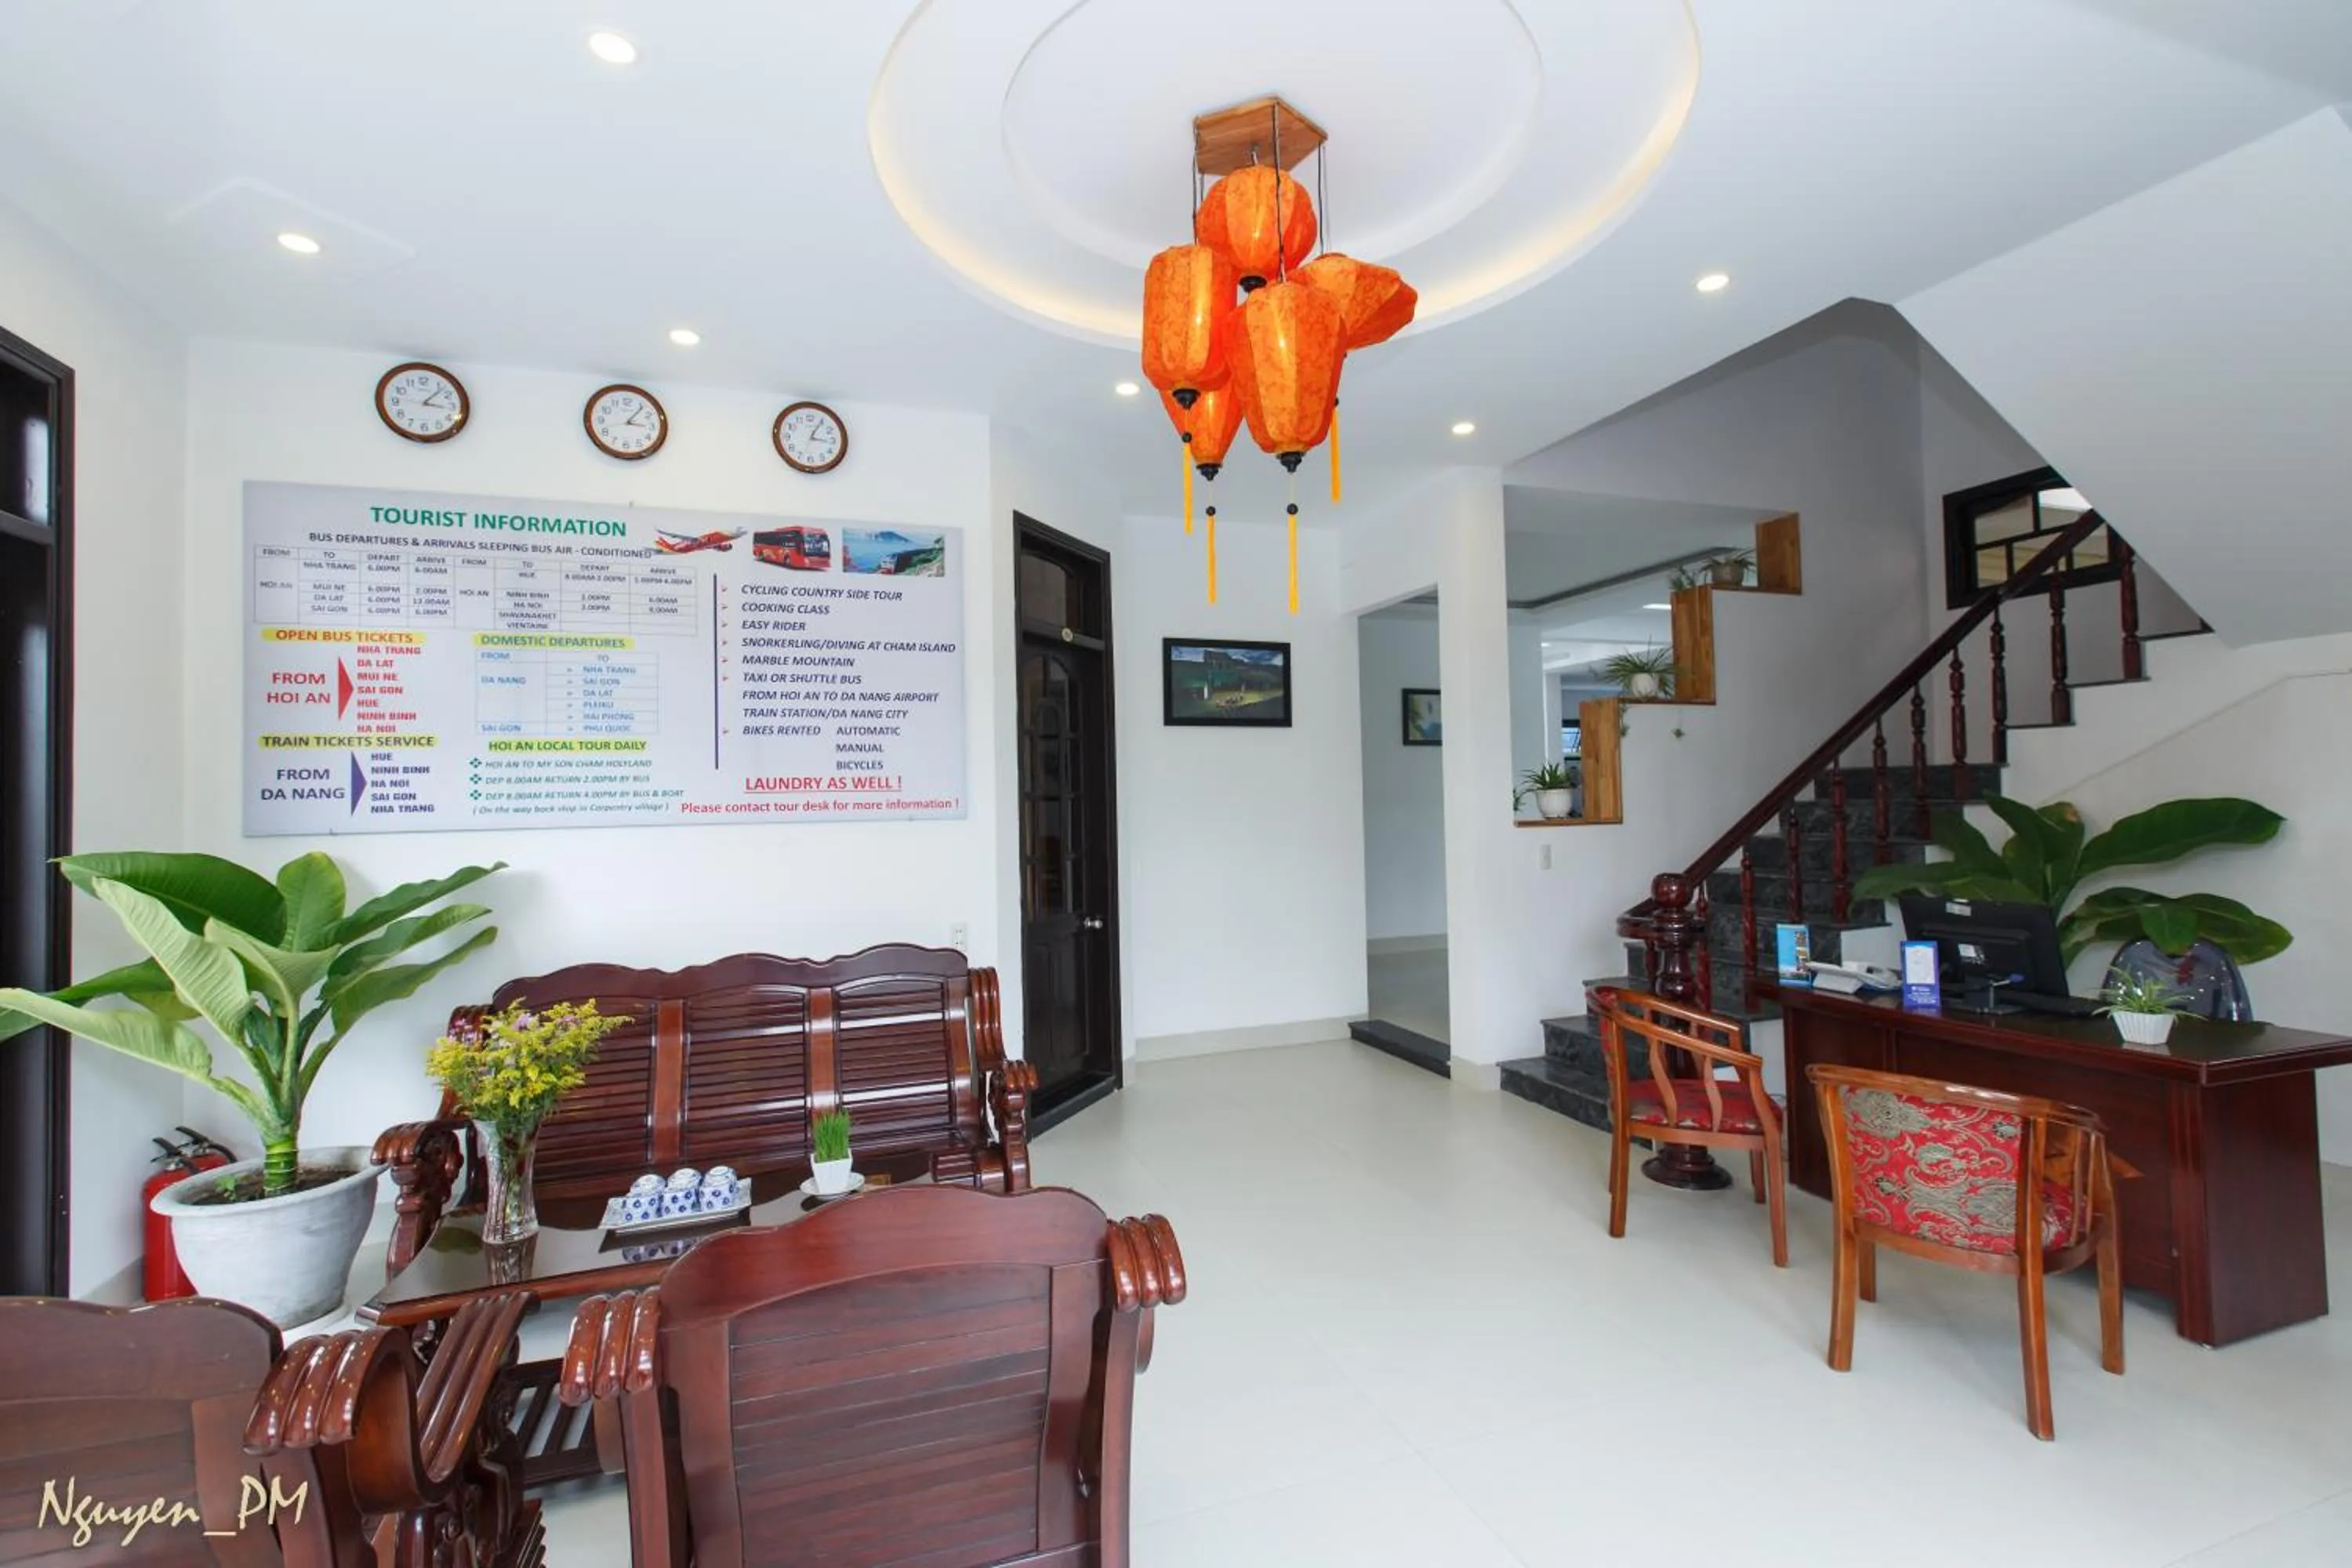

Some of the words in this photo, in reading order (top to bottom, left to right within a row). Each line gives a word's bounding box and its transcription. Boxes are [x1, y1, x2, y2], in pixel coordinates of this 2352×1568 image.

[370, 507, 466, 528] TOURIST
[474, 513, 626, 537] INFORMATION
[310, 532, 332, 543] BUS
[336, 534, 408, 546] DEPARTURES
[411, 538, 419, 546] &
[423, 539, 476, 550] ARRIVALS
[478, 541, 528, 553] SLEEPING
[532, 545, 552, 554] BUS
[555, 546, 572, 555] AIR
[581, 546, 652, 559] CONDITIONED
[741, 584, 789, 597] CYCLING
[791, 586, 844, 599] COUNTRY
[847, 589, 870, 600] SIDE
[874, 590, 902, 601] TOUR
[741, 602, 794, 614] COOKING
[797, 604, 830, 615] CLASS
[742, 620, 771, 630] EASY
[772, 621, 807, 632] RIDER
[276, 629, 318, 641] OPEN
[322, 630, 352, 641] BUS
[357, 632, 413, 643] TICKETS
[481, 634, 546, 647] DOMESTIC
[549, 637, 626, 648] DEPARTURES
[358, 644, 381, 654] NHA
[385, 646, 421, 655] TRANG
[742, 637, 865, 652] SNORKERLING/DIVING
[867, 641, 881, 652] AT
[884, 642, 917, 652] CHAM
[918, 643, 956, 653] ISLAND
[358, 659, 372, 668] DA
[376, 659, 394, 668] LAT
[742, 655, 789, 666] MARBLE
[792, 656, 856, 667] MOUNTAIN
[272, 673, 325, 684] FROM
[358, 673, 379, 681] MUI
[383, 673, 399, 681] NE
[742, 673, 768, 683] TAXI
[770, 673, 787, 683] OR
[789, 673, 837, 684] SHUTTLE
[840, 674, 863, 685] BUS
[357, 685, 376, 694] SAI
[379, 686, 404, 695] GON
[267, 692, 299, 704] HOI
[305, 692, 331, 704] AN
[358, 699, 379, 707] HUE
[742, 691, 777, 701] FROM
[780, 691, 801, 702] HOI
[804, 691, 820, 702] AN
[824, 692, 838, 702] TO
[841, 692, 858, 703] DA
[861, 692, 891, 704] NANG
[893, 693, 940, 704] AIRPORT
[358, 711, 386, 720] NINH
[389, 712, 417, 720] BINH
[743, 708, 778, 719] TRAIN
[781, 708, 848, 720] STATION/DA
[851, 710, 883, 720] NANG
[886, 710, 909, 720] CITY
[358, 724, 372, 733] HA
[376, 725, 397, 734] NOI
[742, 726, 775, 737] BIKES
[778, 726, 822, 737] RENTED
[836, 727, 902, 737] AUTOMATIC
[263, 735, 310, 747] TRAIN
[314, 735, 372, 747] TICKETS
[376, 736, 434, 747] SERVICE
[488, 740, 513, 751] HOI
[516, 741, 534, 751] AN
[537, 741, 575, 751] LOCAL
[579, 741, 611, 751] TOUR
[614, 741, 648, 751] DAILY
[836, 744, 884, 754] MANUAL
[372, 753, 393, 762] HUE
[371, 766, 399, 775] NINH
[402, 765, 430, 775] BINH
[836, 760, 884, 771] BICYCLES
[277, 768, 330, 780] FROM
[371, 779, 387, 788] HA
[390, 779, 410, 788] NOI
[745, 777, 822, 792] LAUNDRY
[827, 777, 848, 791] AS
[851, 776, 894, 790] WELL
[261, 789, 287, 800] DA
[292, 788, 346, 800] NANG
[372, 793, 390, 801] SAI
[393, 793, 417, 801] GON
[371, 804, 395, 814] NHA
[398, 804, 435, 813] TRANG
[681, 801, 722, 815] Please
[725, 801, 771, 812] contact
[774, 800, 798, 812] tour
[802, 799, 829, 811] desk
[833, 799, 850, 812] for
[852, 800, 883, 811] more
[885, 797, 953, 811] information
